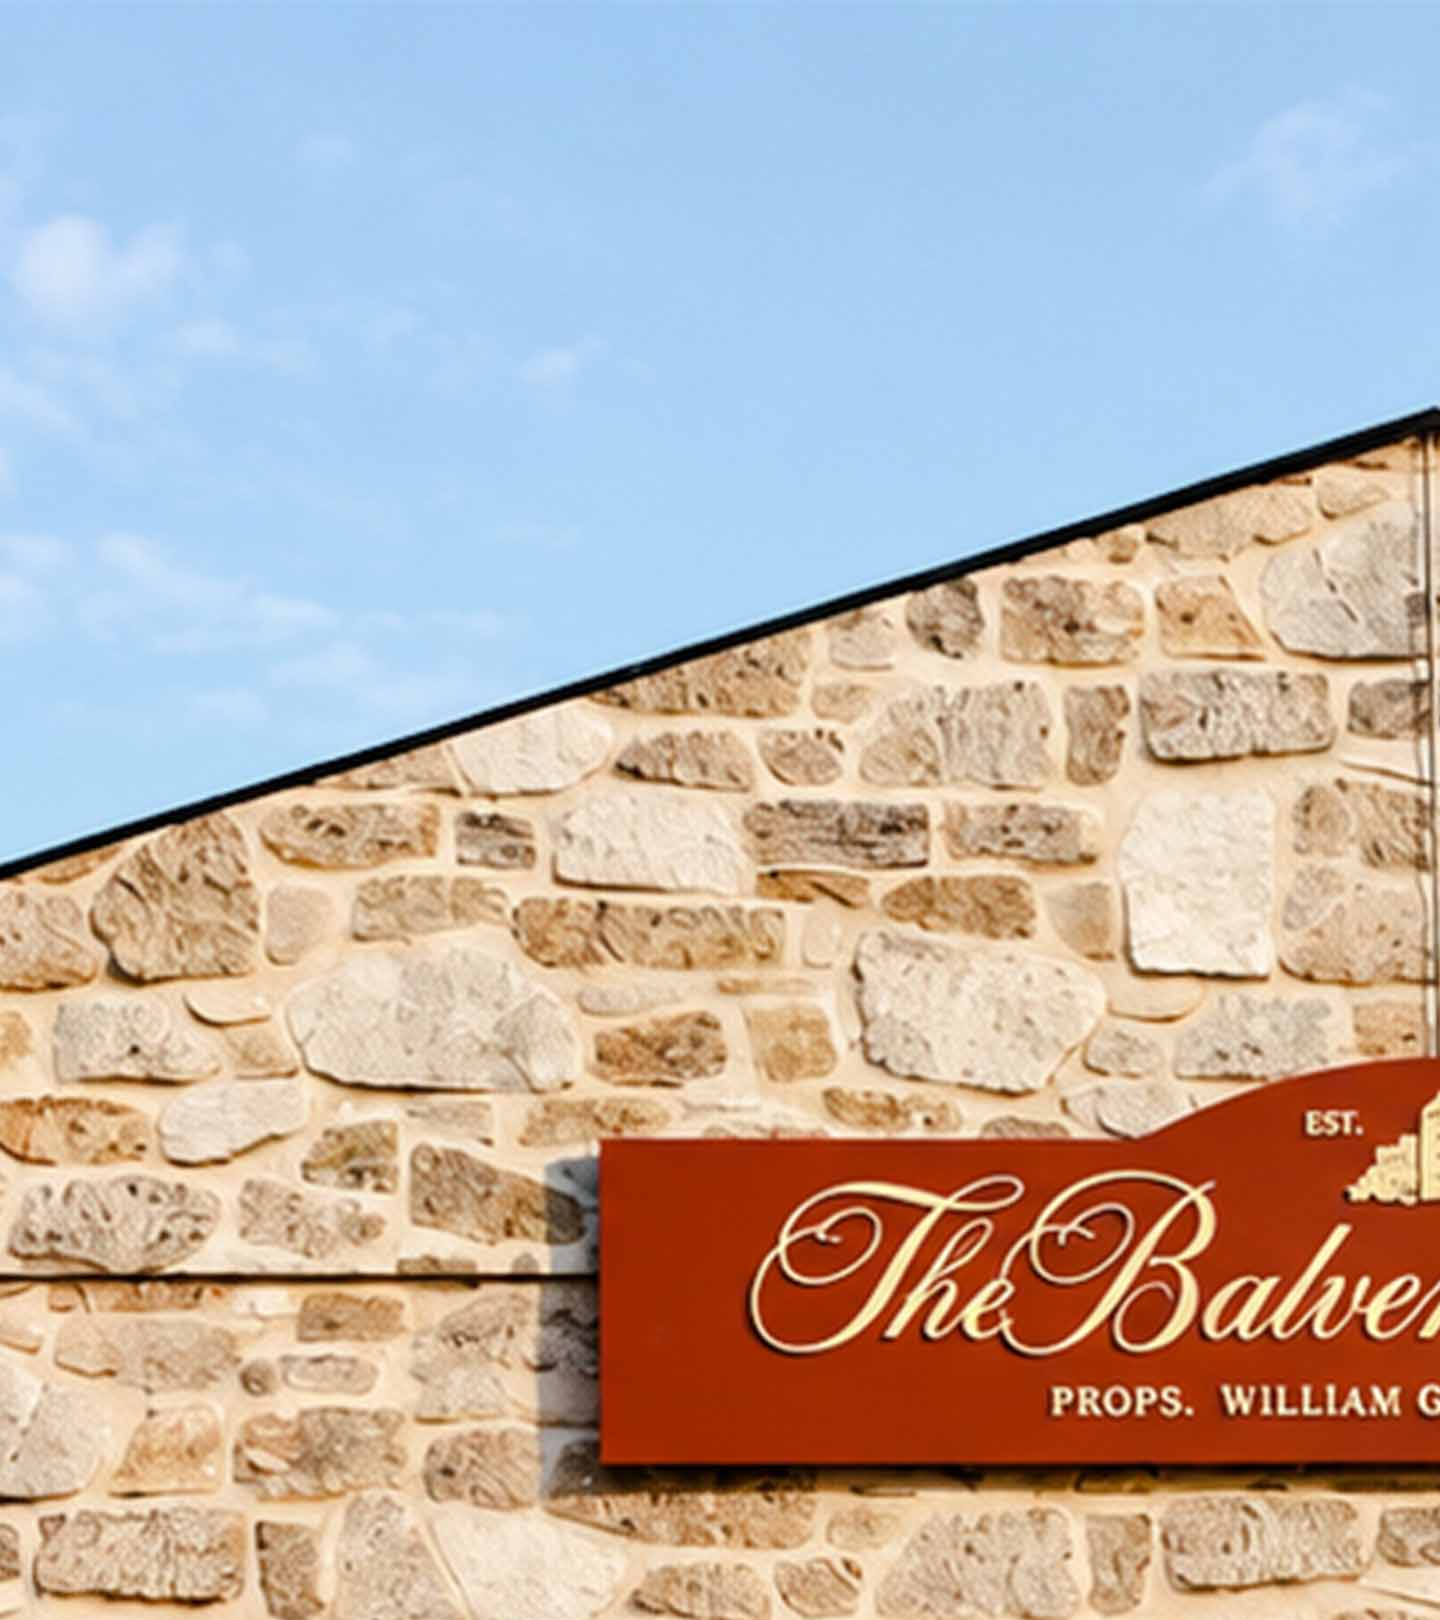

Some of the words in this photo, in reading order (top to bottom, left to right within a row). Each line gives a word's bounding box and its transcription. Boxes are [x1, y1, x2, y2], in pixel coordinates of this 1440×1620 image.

[1305, 1109, 1364, 1137] EST.
[750, 1174, 1025, 1353] The
[1050, 1384, 1195, 1417] PROPS.
[1220, 1383, 1402, 1417] WILLIAM
